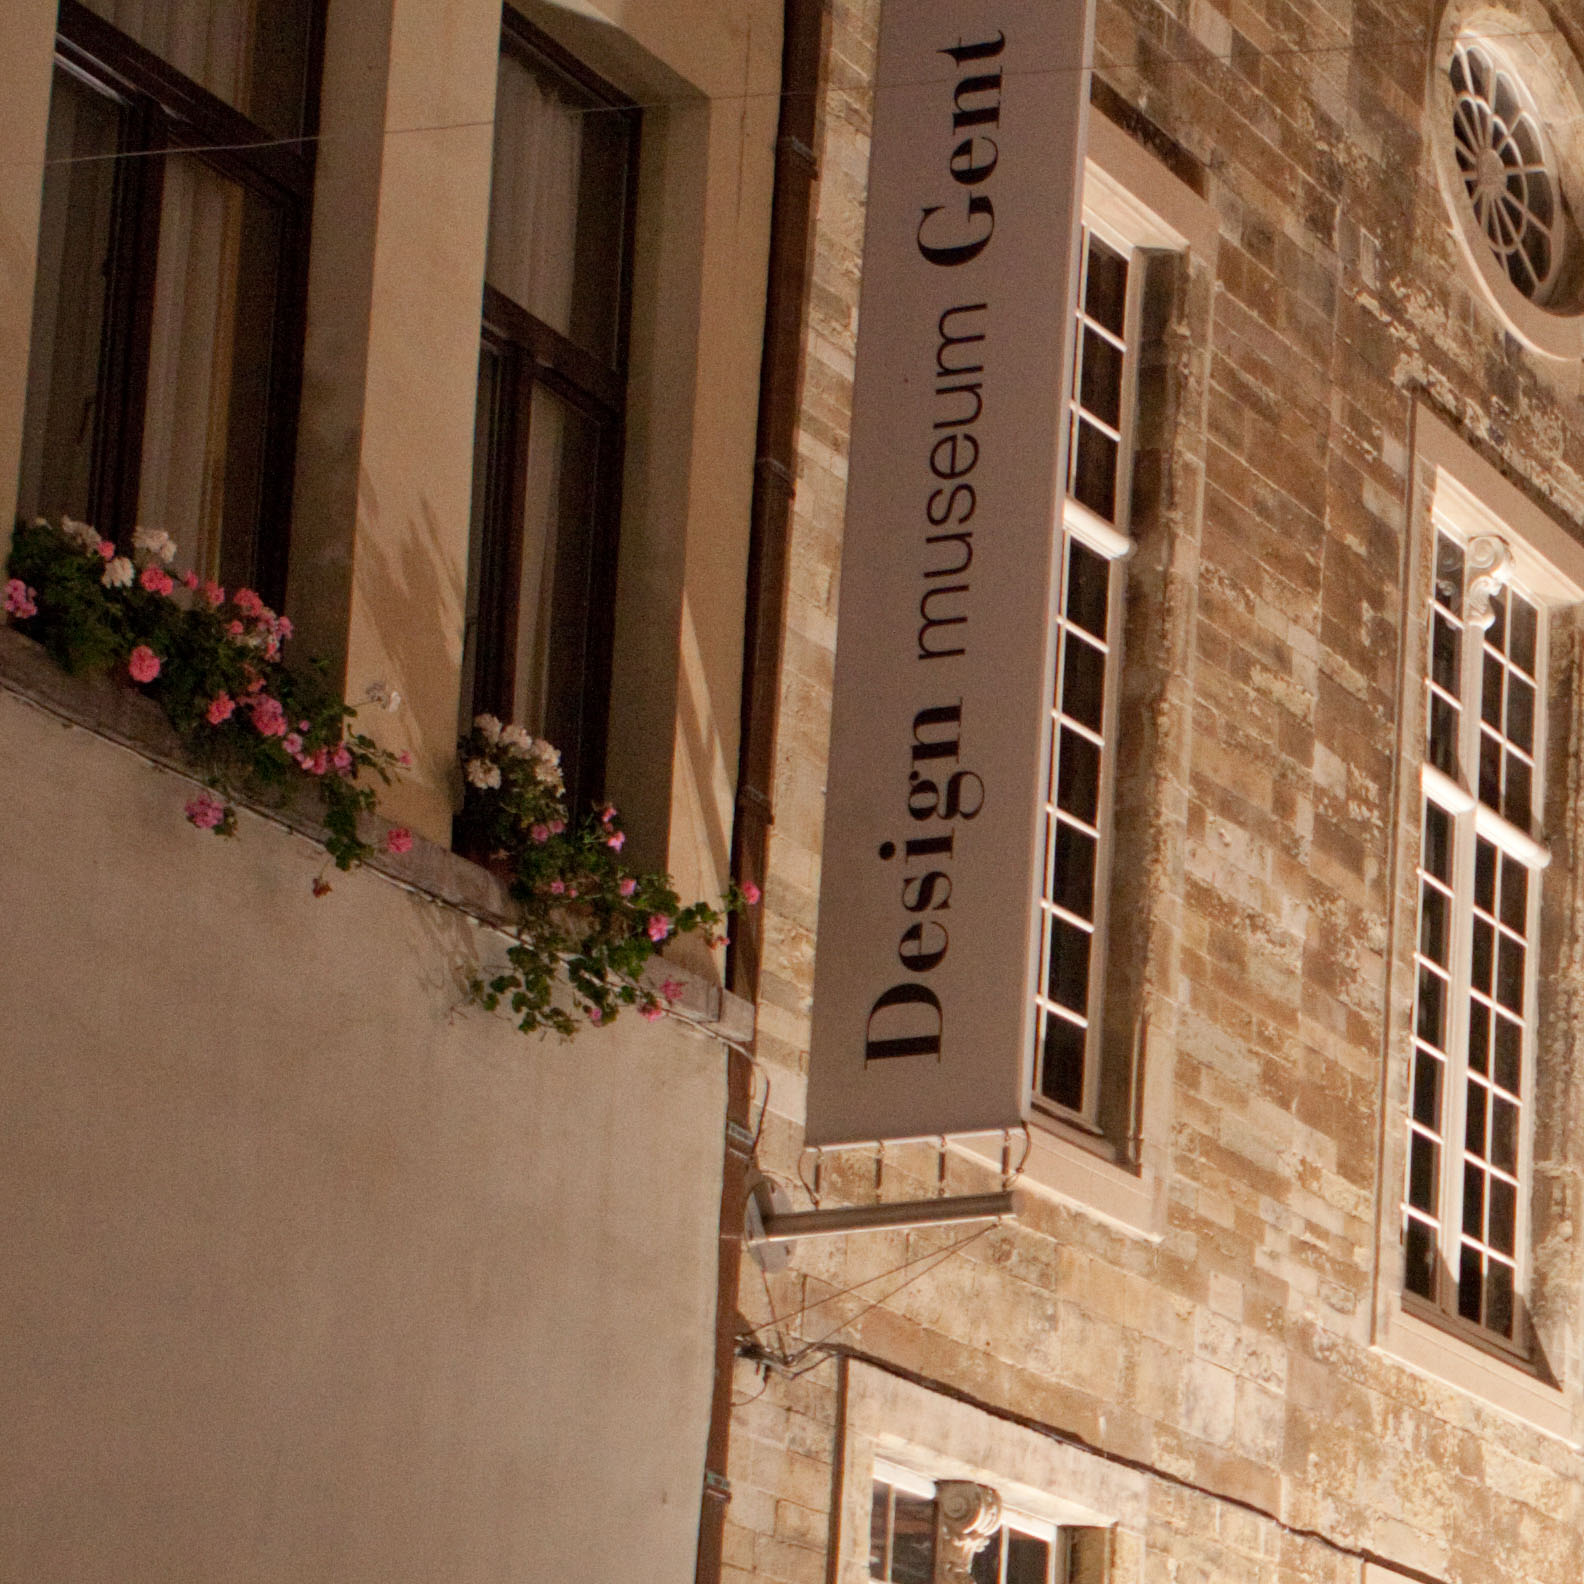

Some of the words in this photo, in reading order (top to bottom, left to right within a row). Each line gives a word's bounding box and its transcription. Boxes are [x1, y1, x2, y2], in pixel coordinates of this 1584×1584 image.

[915, 29, 1008, 267] Gent
[915, 302, 988, 661] museum
[862, 698, 985, 1070] Design
